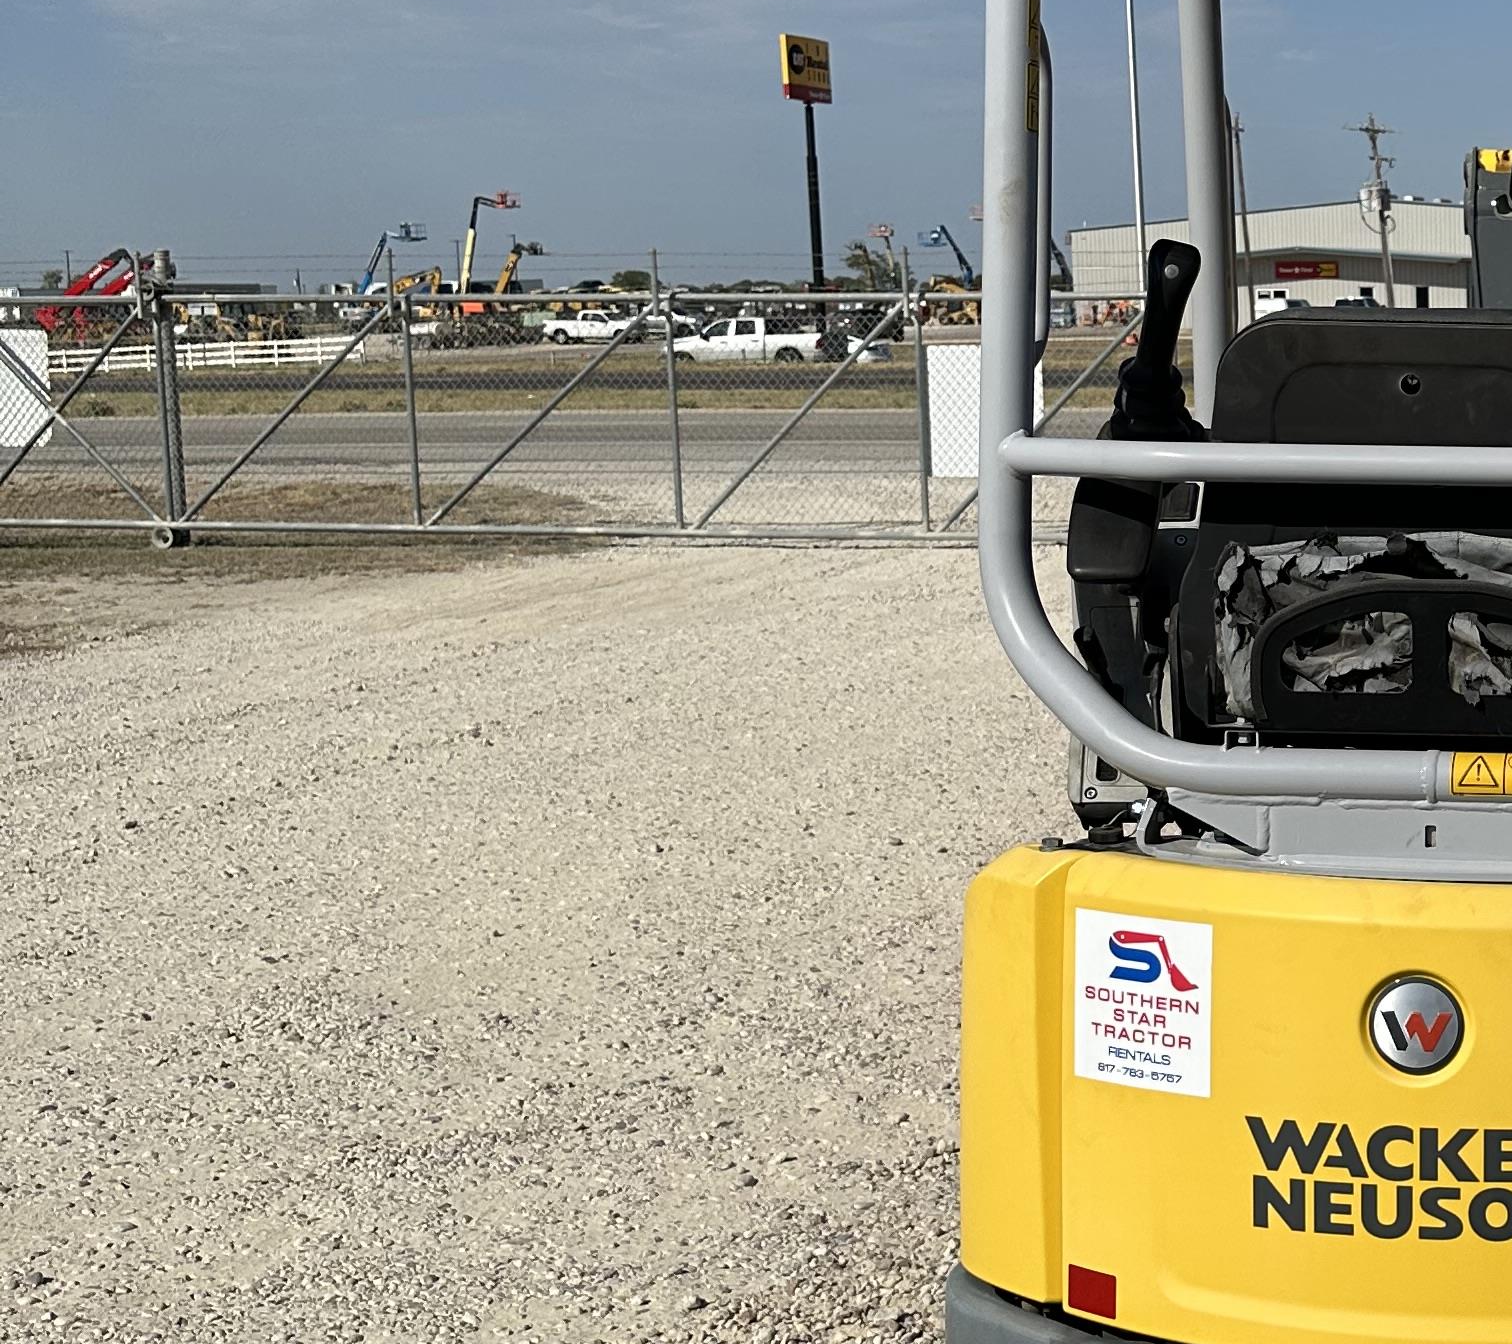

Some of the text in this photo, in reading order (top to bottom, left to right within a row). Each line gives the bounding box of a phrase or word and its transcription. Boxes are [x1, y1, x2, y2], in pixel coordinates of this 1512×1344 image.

[1084, 985, 1200, 1015] SOUTHERN
[1113, 1008, 1166, 1029] STAR
[1091, 1022, 1192, 1050] TRACTOR
[1108, 1045, 1172, 1066] RENTALS
